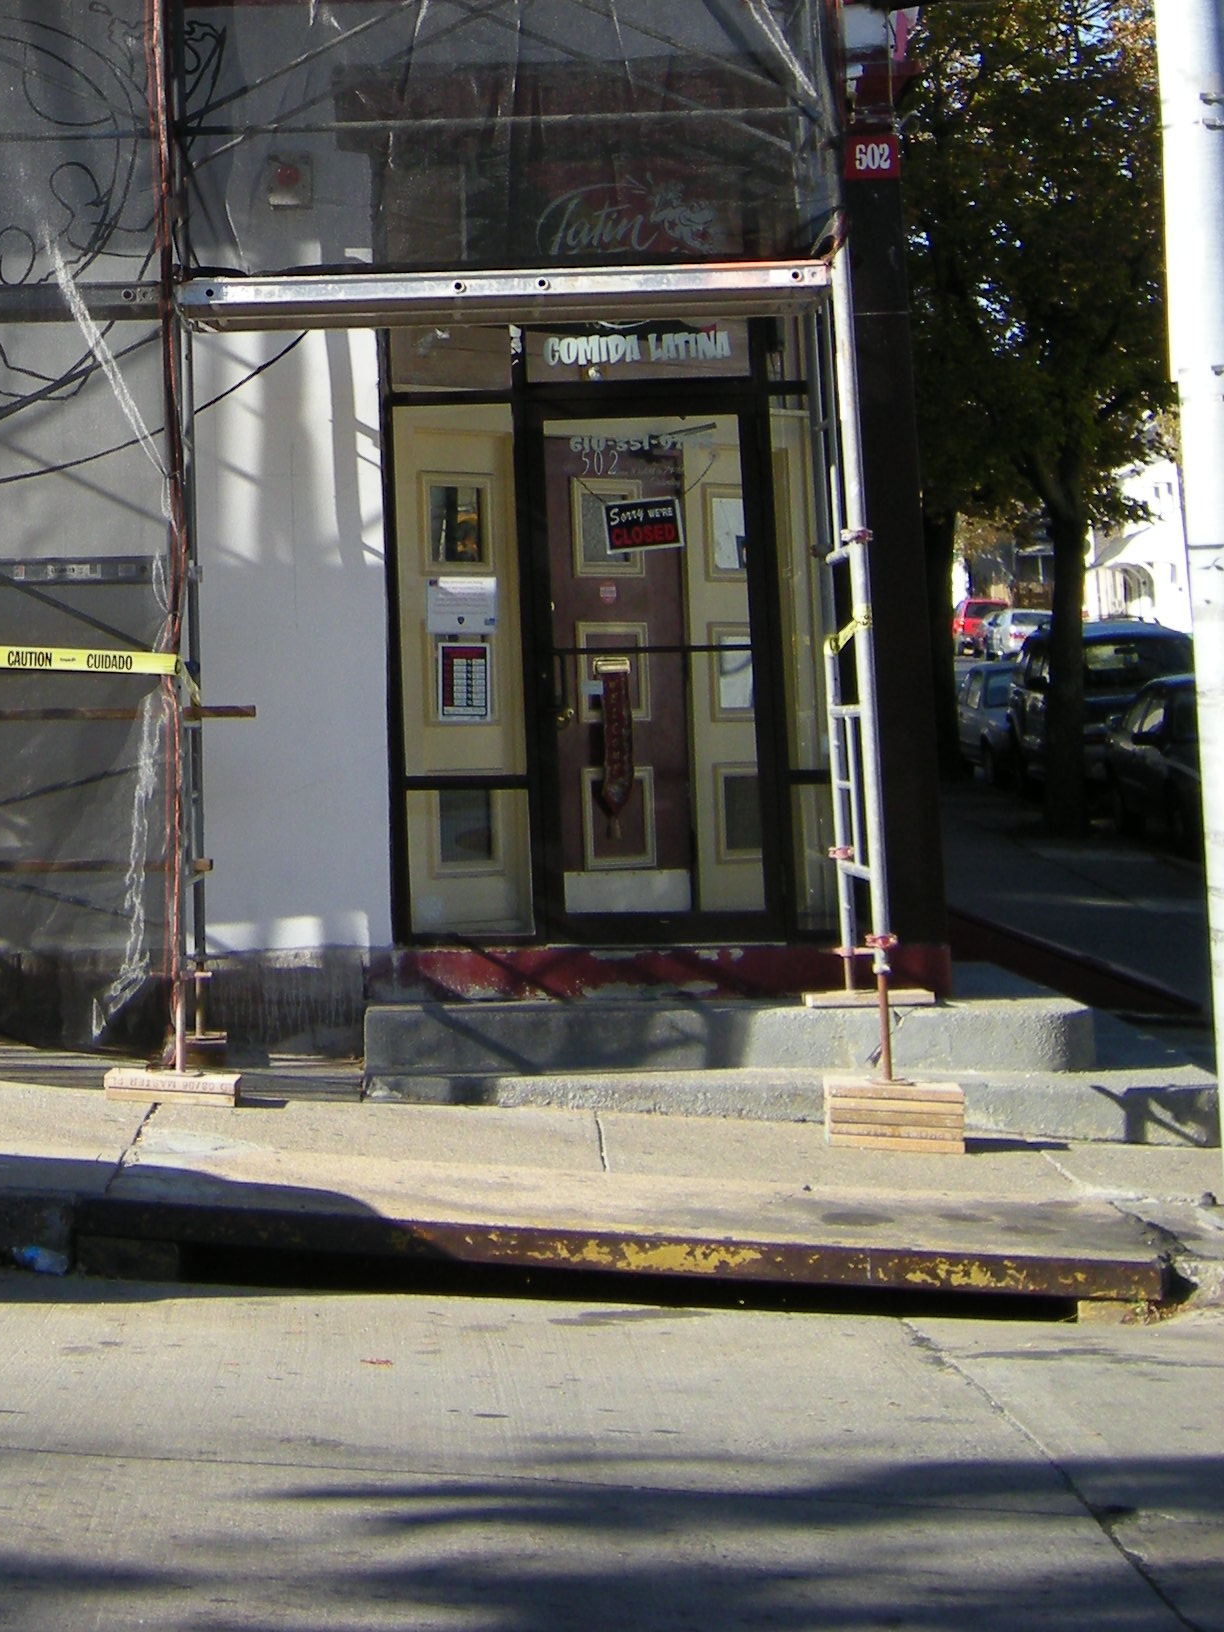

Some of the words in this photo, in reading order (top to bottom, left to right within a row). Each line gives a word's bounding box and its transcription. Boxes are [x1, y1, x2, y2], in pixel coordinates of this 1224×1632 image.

[542, 194, 660, 255] Latin
[543, 333, 641, 366] COMIDA
[648, 330, 732, 362] LATINA
[581, 449, 619, 476] 502
[610, 506, 644, 526] Sorry
[647, 506, 674, 519] WE'RE
[612, 522, 676, 546] CLOSED
[7, 650, 53, 668] CAUTION
[86, 653, 133, 671] CUIDADO
